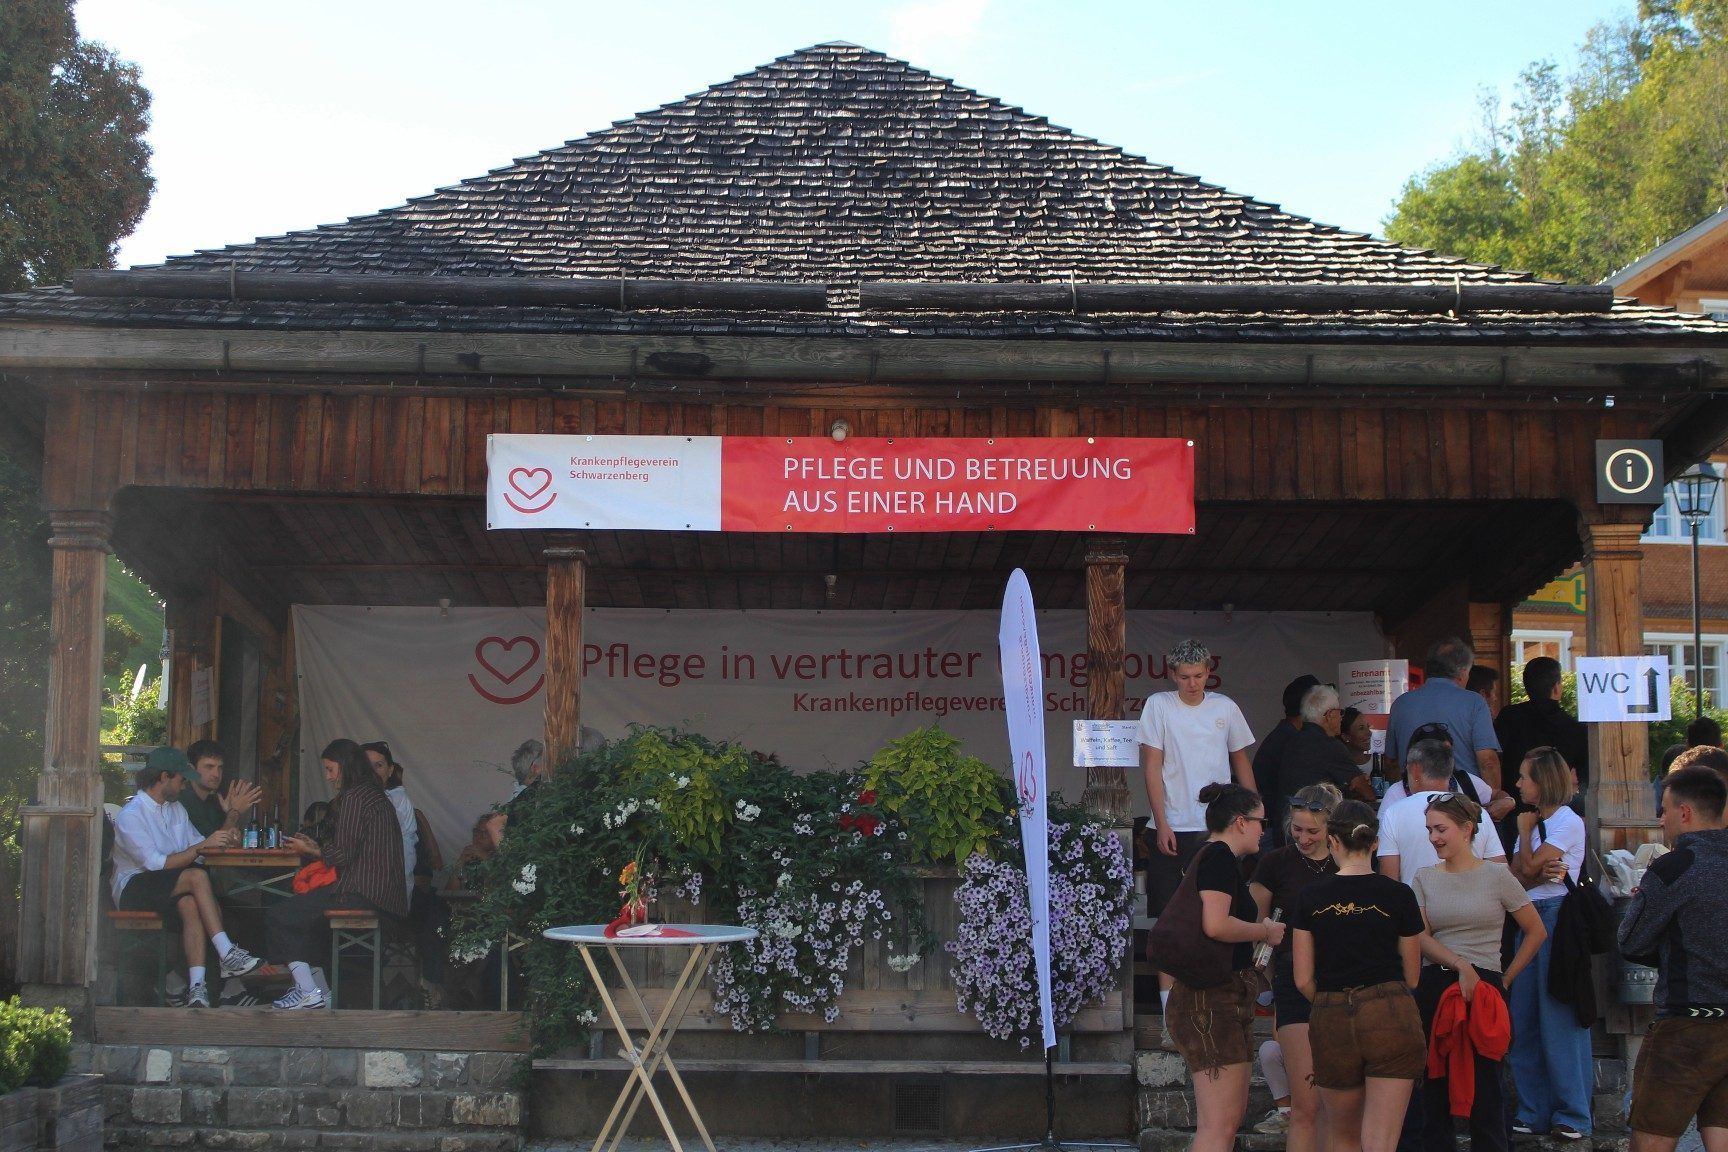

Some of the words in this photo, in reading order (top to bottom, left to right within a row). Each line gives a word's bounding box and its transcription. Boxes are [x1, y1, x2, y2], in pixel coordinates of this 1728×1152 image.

[570, 456, 679, 469] Krankenpflegeverein
[783, 457, 884, 480] PFLEGE
[894, 457, 956, 480] UND
[966, 457, 1132, 480] BETREUUNG
[569, 470, 650, 483] Schwarzenberg
[782, 490, 838, 513] AUS
[847, 491, 926, 514] EINER
[935, 491, 1018, 514] HAND
[582, 642, 706, 688] Pflege
[721, 645, 756, 680] in
[769, 646, 982, 681] vertrauter
[1582, 672, 1631, 694] WC
[793, 690, 1007, 717] Krankenpflegevere
